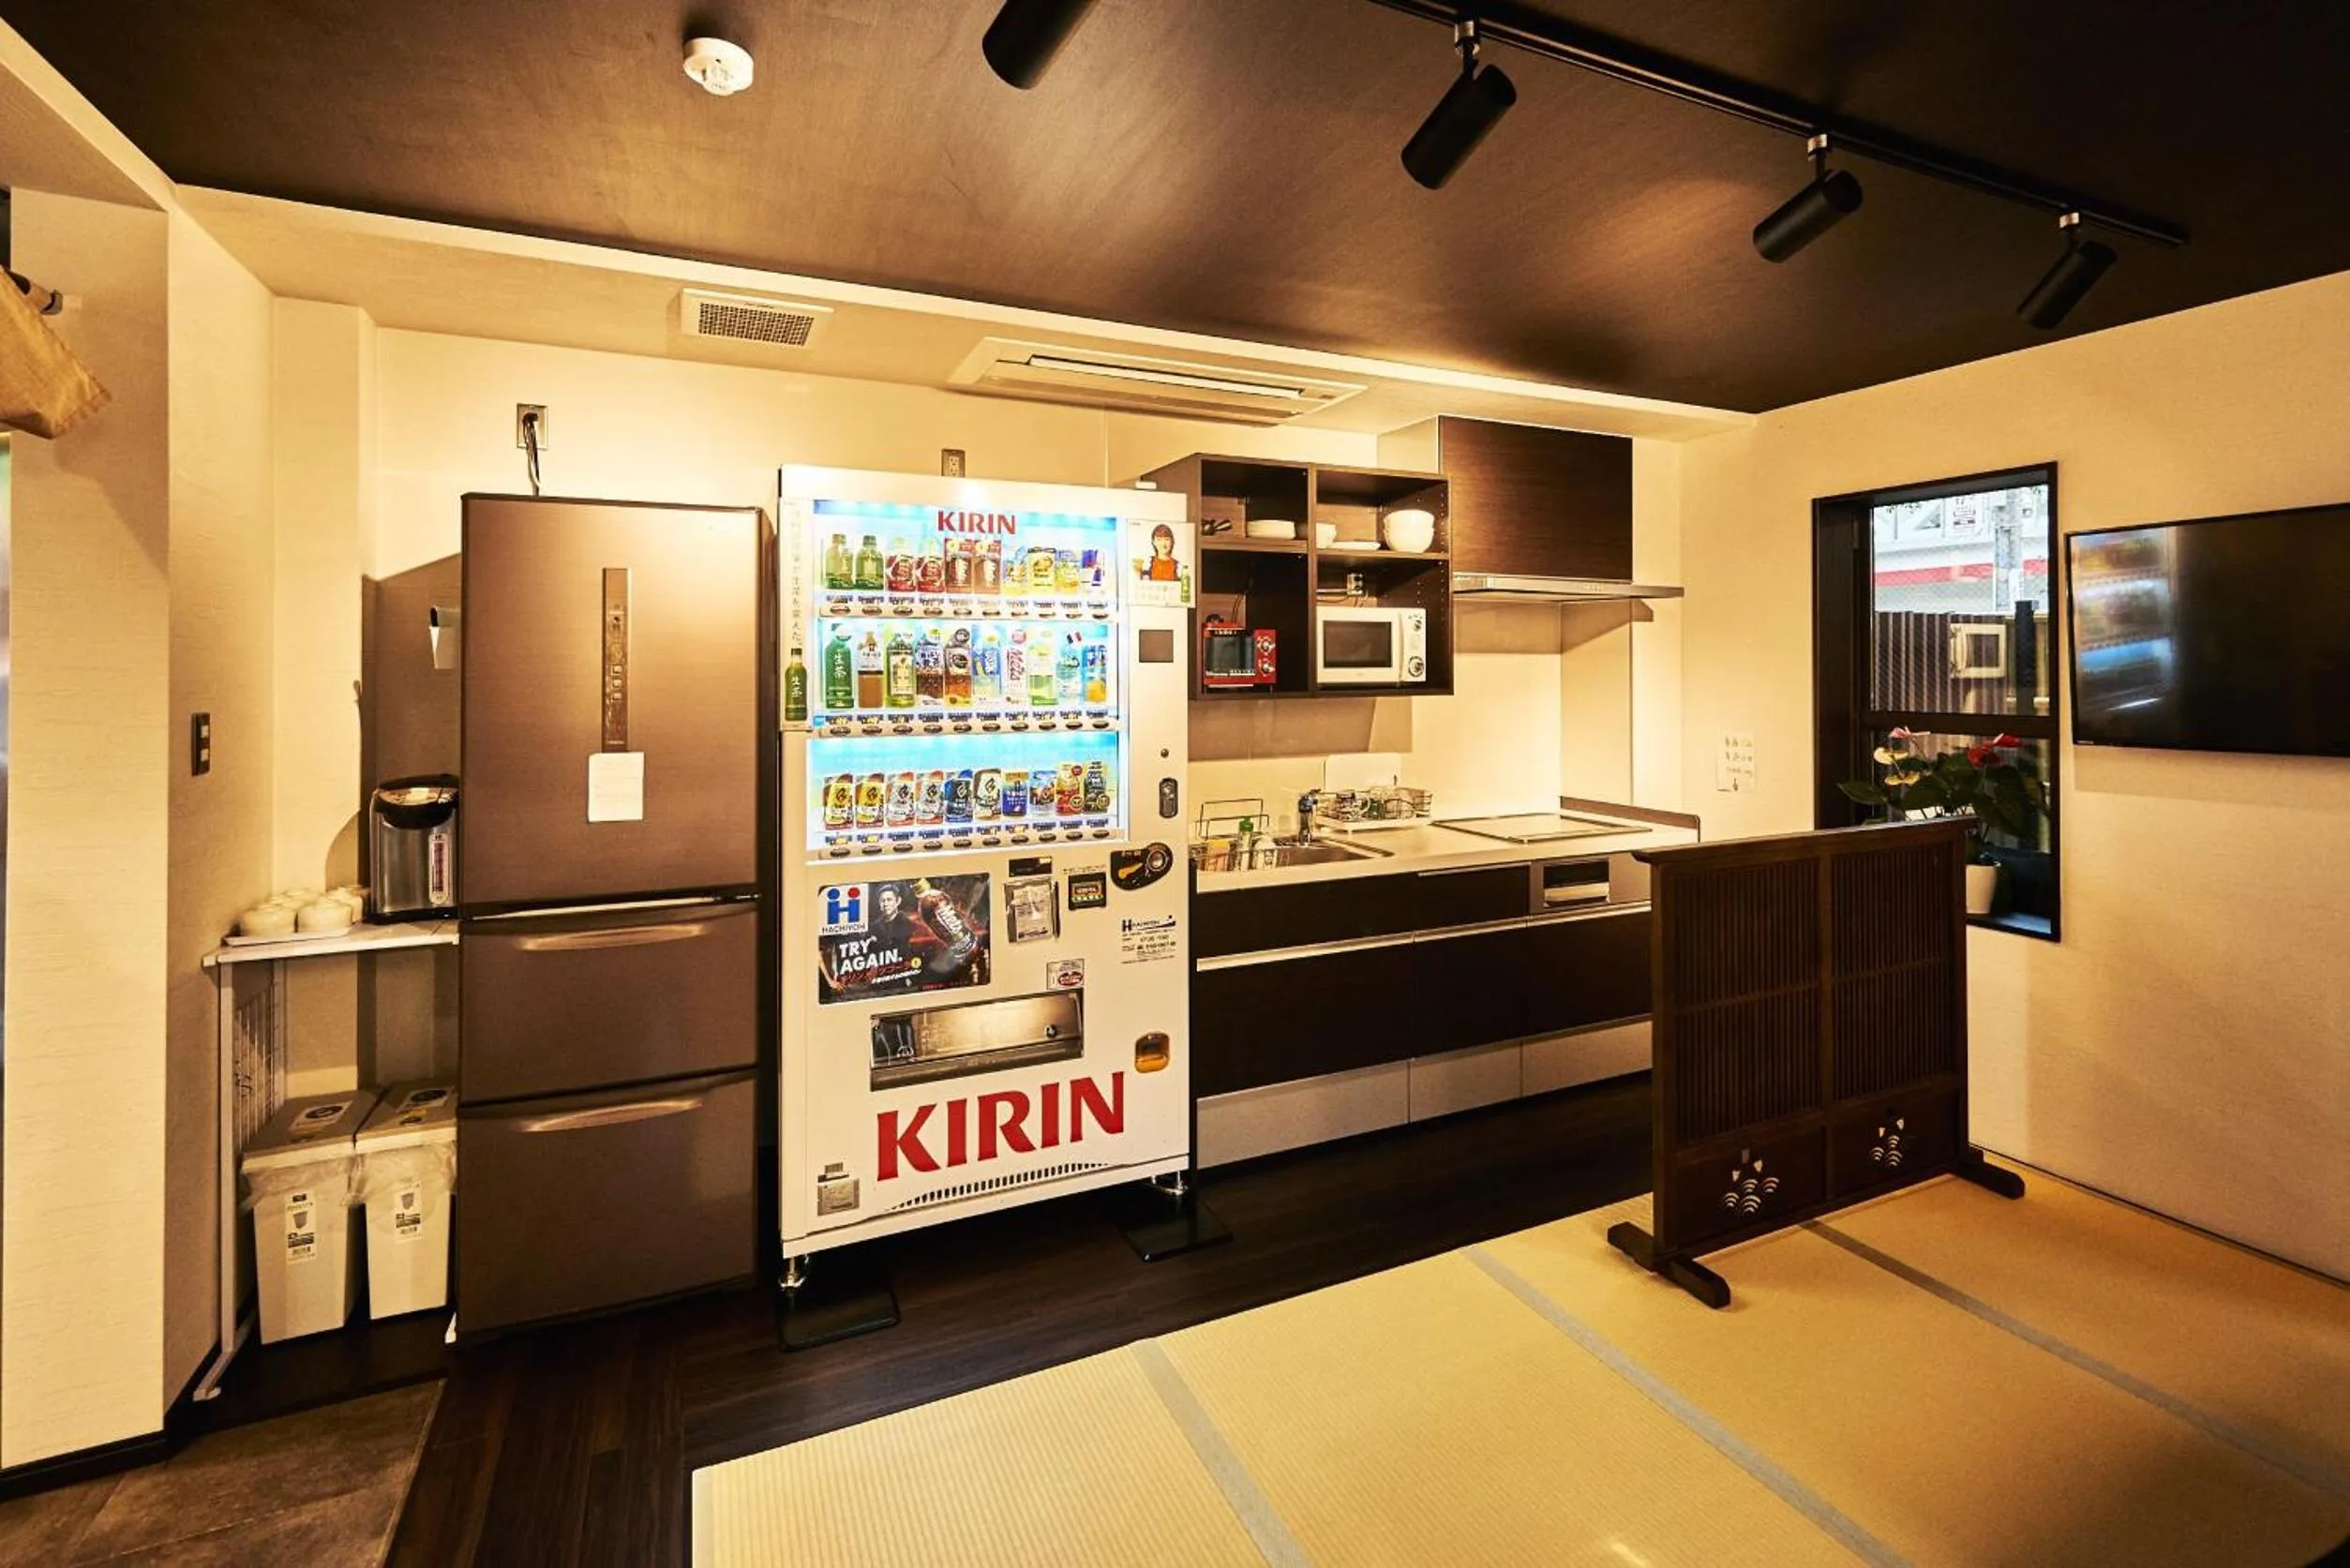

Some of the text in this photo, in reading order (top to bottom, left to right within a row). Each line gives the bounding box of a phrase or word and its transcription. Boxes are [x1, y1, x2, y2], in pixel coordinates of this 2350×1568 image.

[936, 510, 1017, 535] KIRIN
[833, 652, 847, 679] 生茶
[839, 940, 872, 958] TRY
[840, 948, 903, 975] AGAIN.
[876, 1070, 1125, 1181] KIRIN
